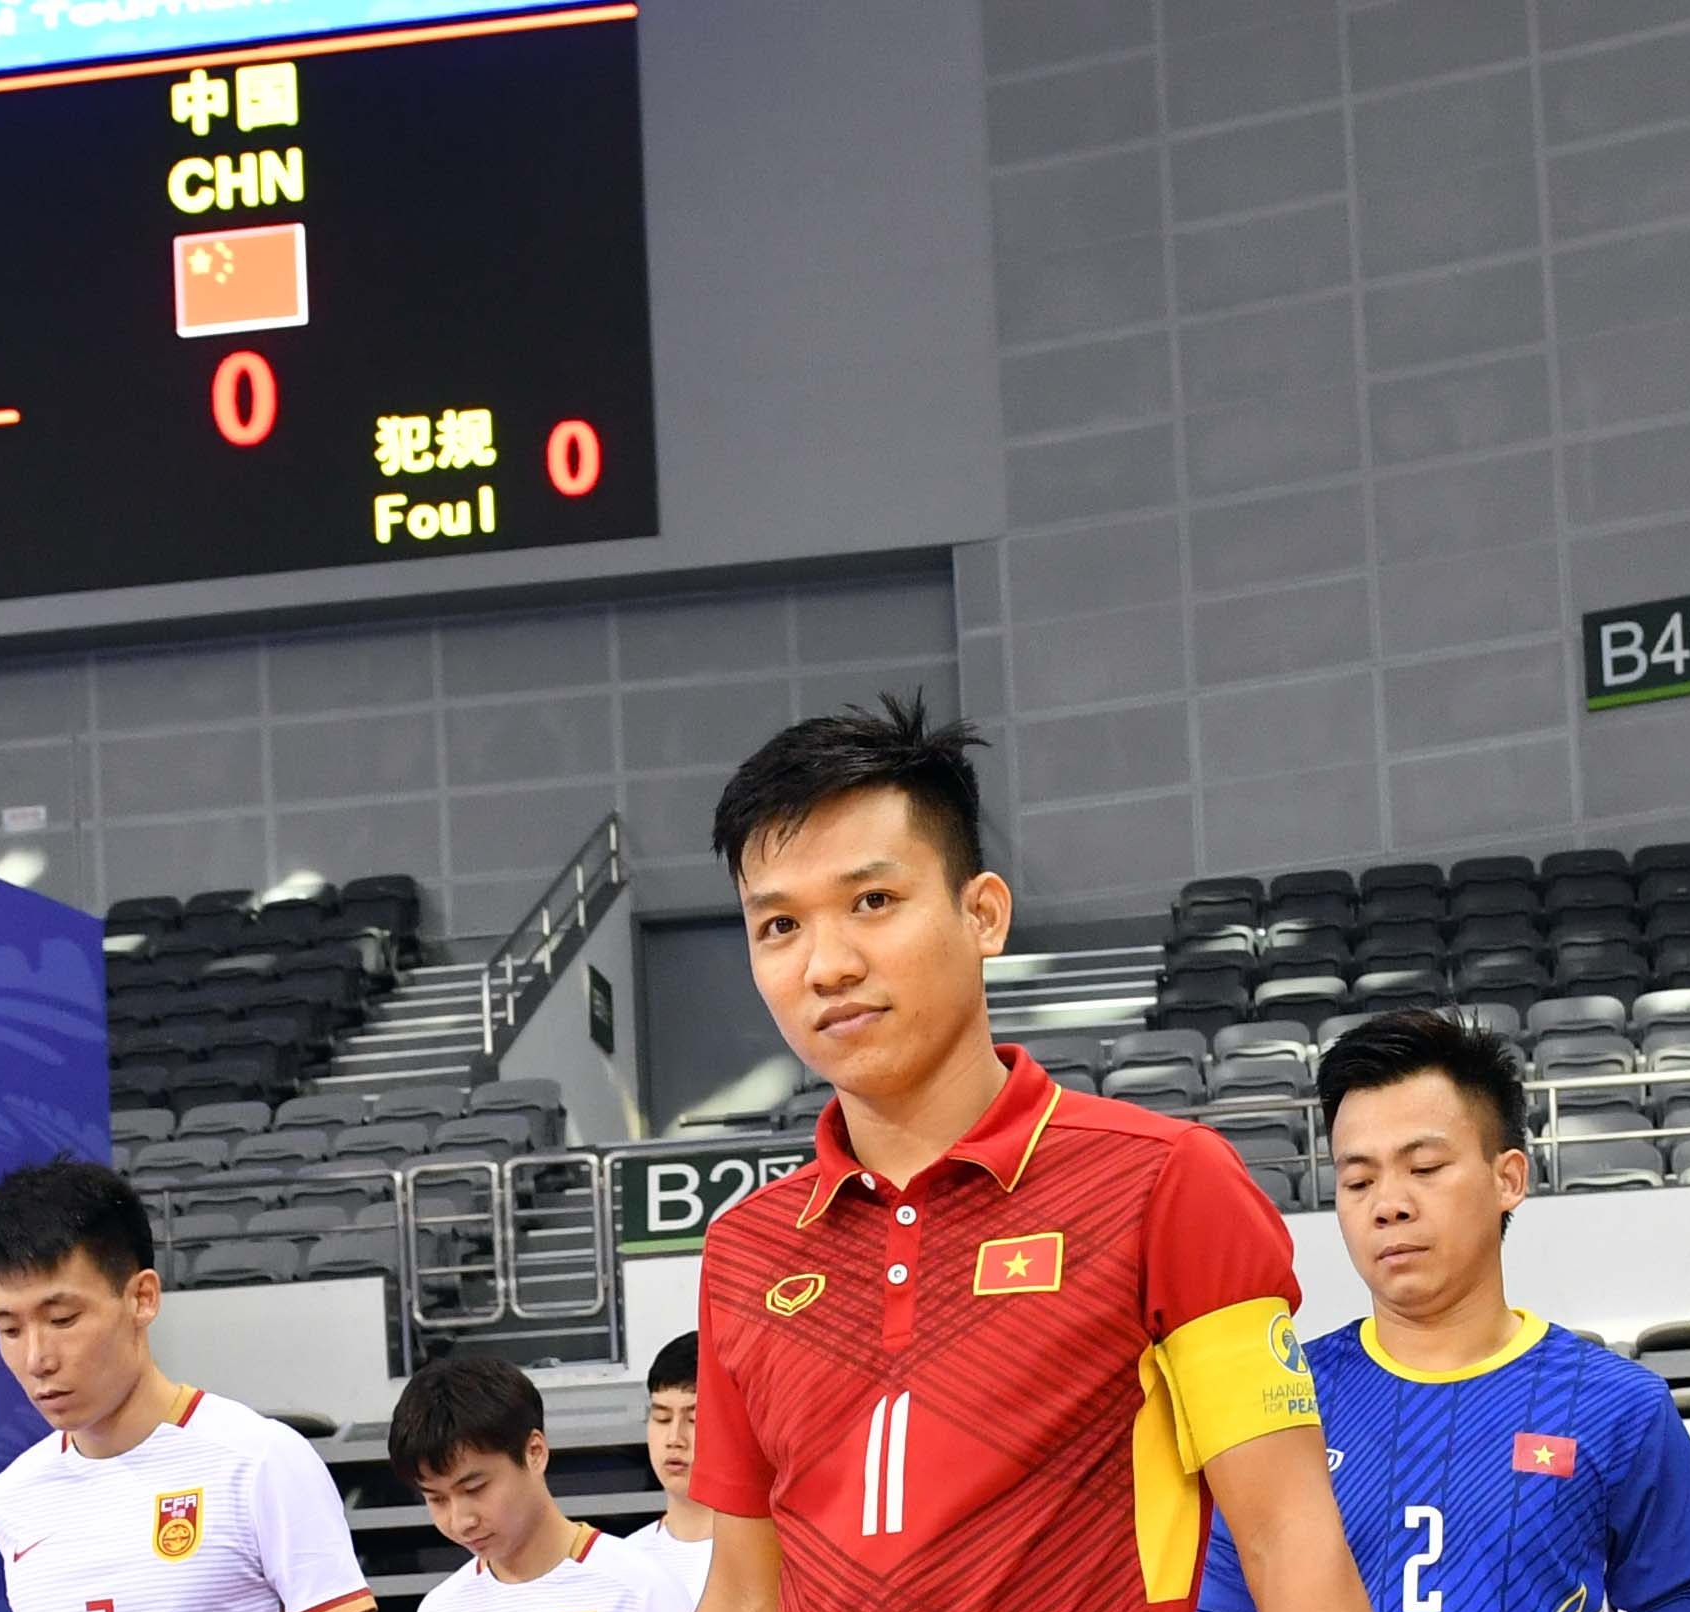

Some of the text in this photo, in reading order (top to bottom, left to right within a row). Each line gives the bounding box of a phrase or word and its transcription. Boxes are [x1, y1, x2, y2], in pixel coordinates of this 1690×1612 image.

[171, 62, 298, 135] 中国
[167, 148, 305, 213] CHN
[212, 350, 277, 446] 0
[375, 408, 496, 475] 犯规
[547, 420, 601, 497] 0
[374, 485, 495, 544] Foul
[862, 1391, 910, 1537] 11
[161, 1494, 197, 1512] CFA
